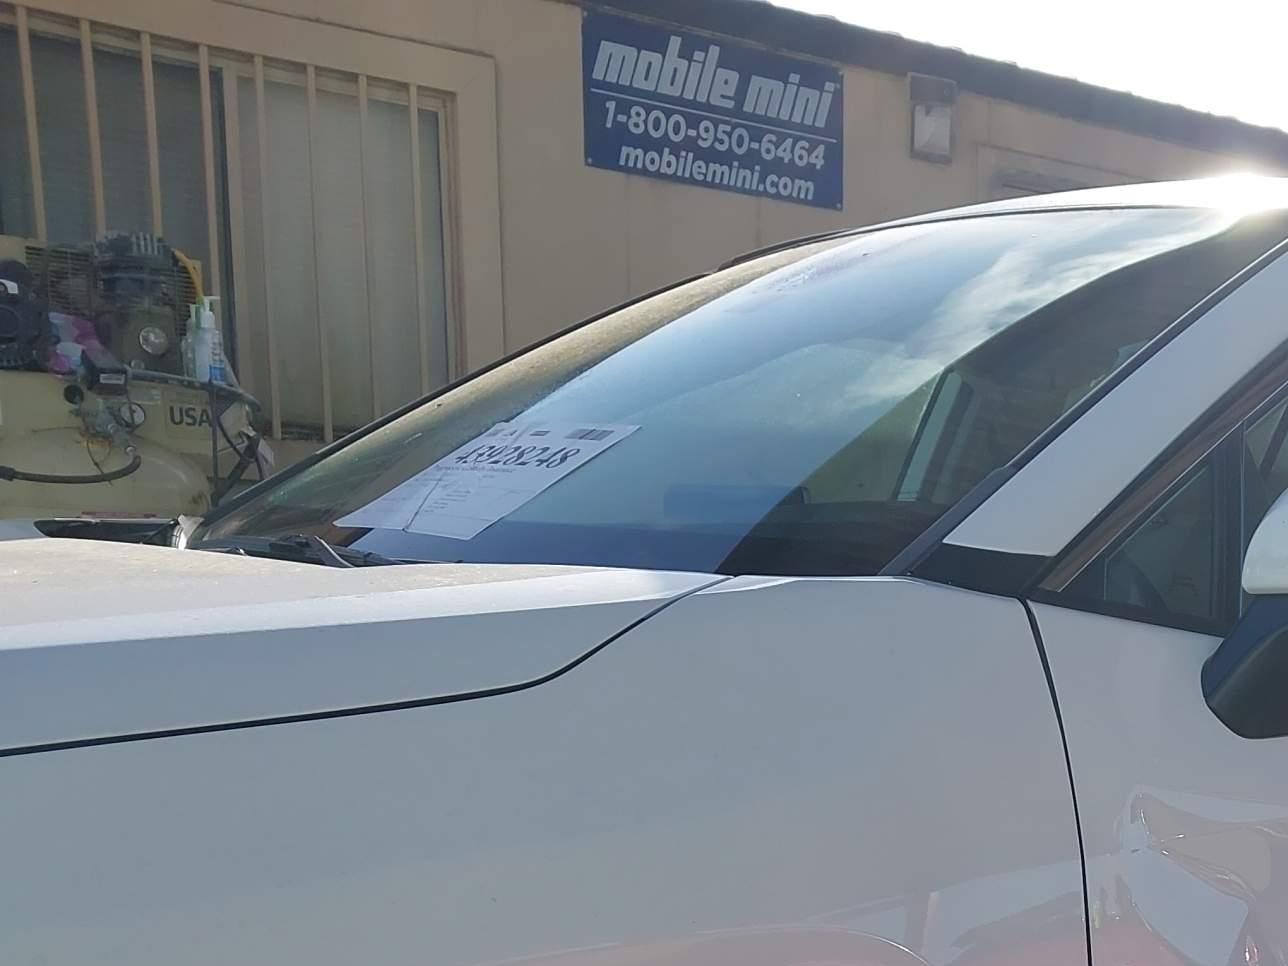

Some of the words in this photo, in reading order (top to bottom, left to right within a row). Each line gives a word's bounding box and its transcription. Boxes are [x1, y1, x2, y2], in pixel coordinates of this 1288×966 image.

[592, 35, 739, 109] mobile
[743, 72, 835, 128] mini
[605, 100, 825, 170] 1-800-950-6464
[618, 144, 815, 201] mobilemini.com
[168, 405, 212, 428] USA
